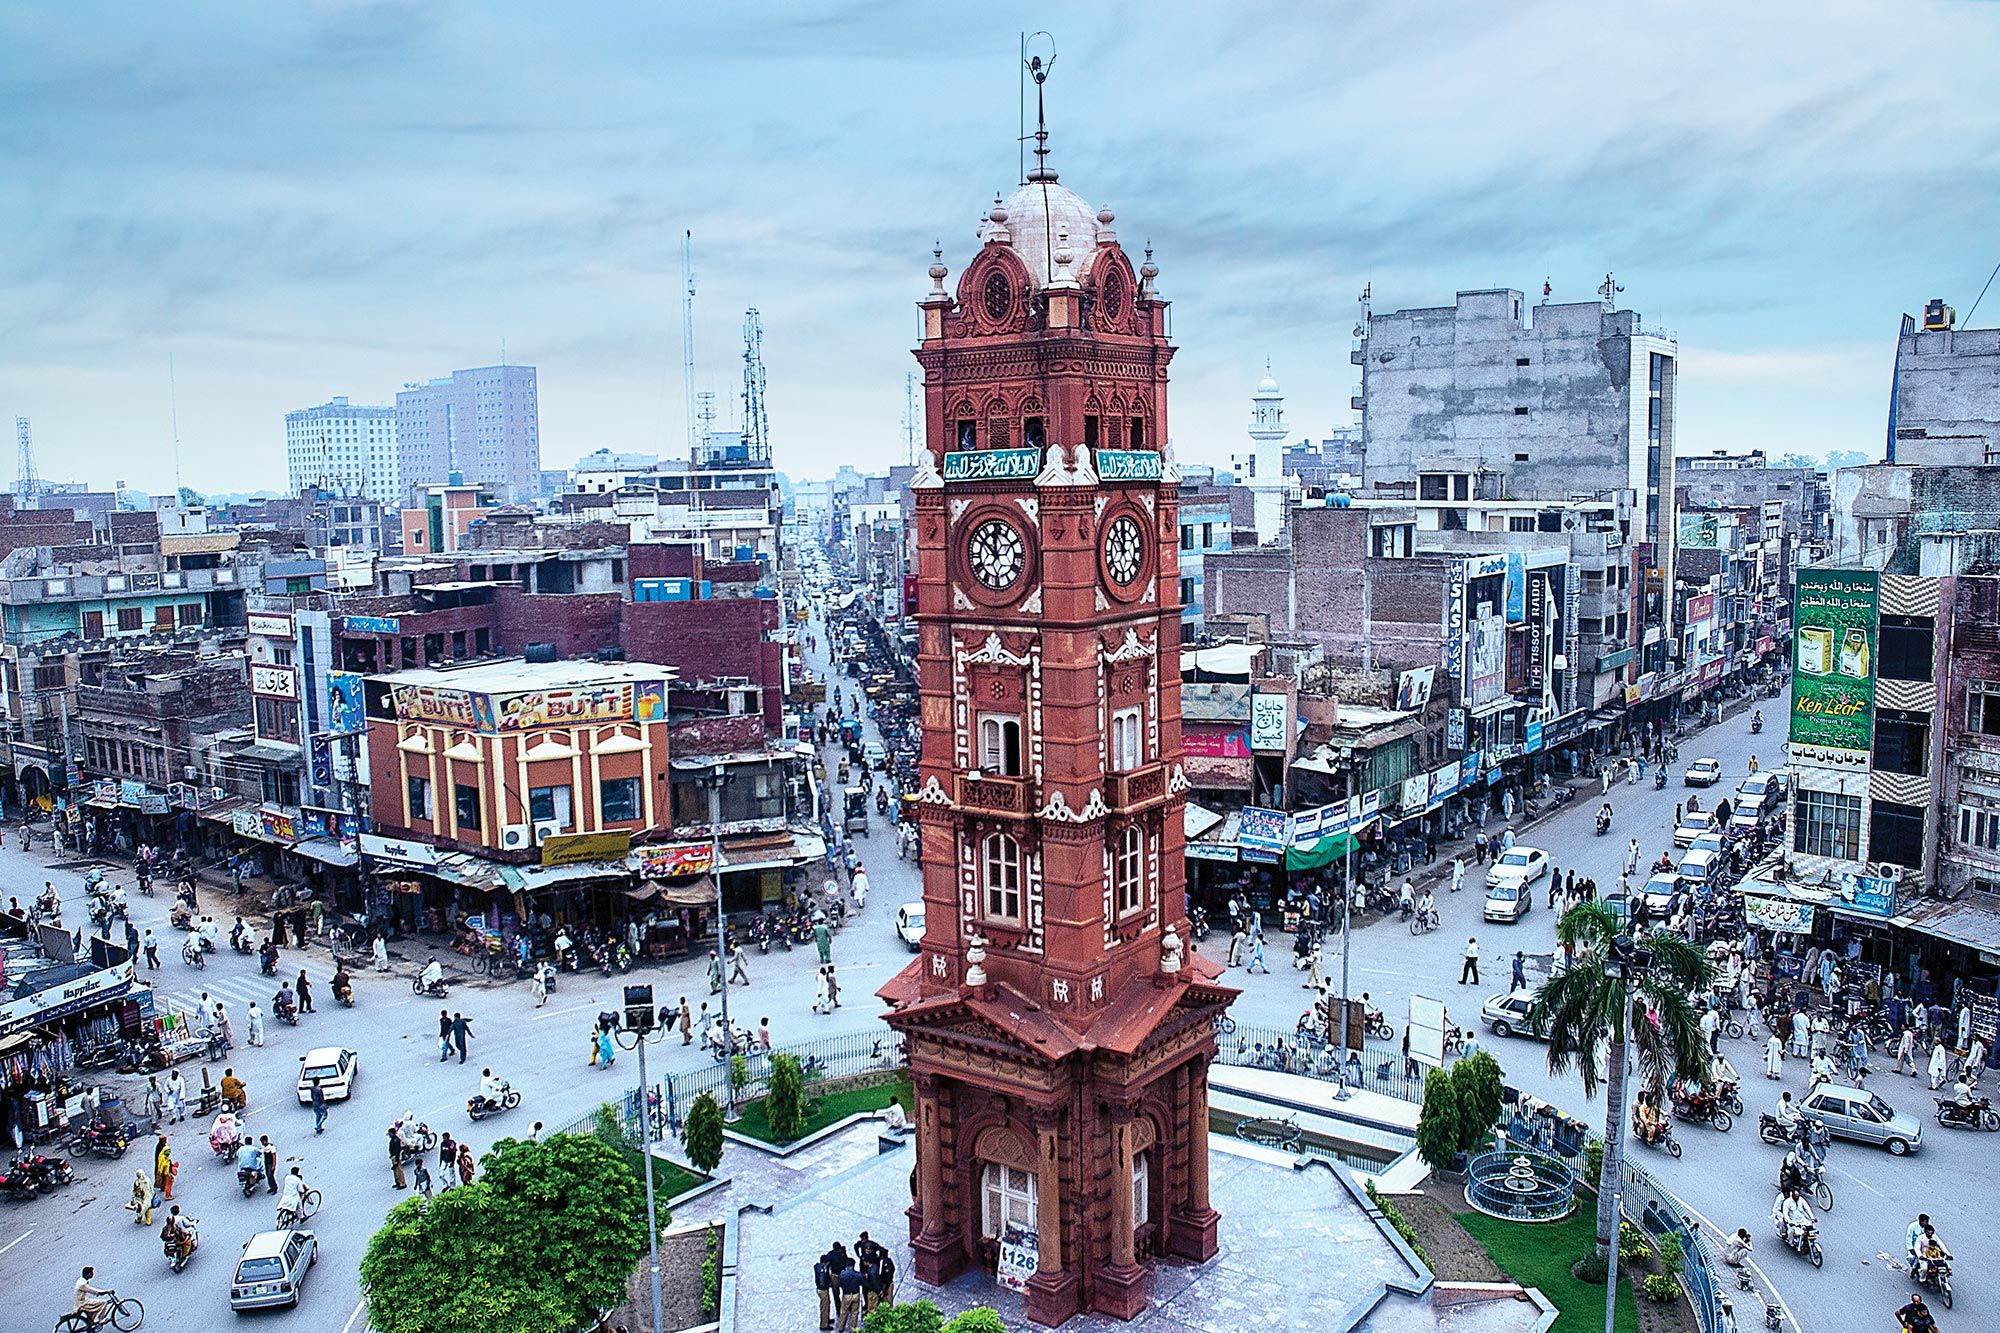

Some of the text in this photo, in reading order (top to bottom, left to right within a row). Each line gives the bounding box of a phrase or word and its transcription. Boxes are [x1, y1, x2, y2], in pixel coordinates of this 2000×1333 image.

[1450, 583, 1462, 628] SAS
[1531, 579, 1541, 617] RADO
[1531, 621, 1541, 665] TISSOT
[421, 698, 464, 719] BUTT
[547, 695, 621, 718] BUTT
[1255, 700, 1284, 715] جاپان
[1796, 697, 1865, 716] Ken Leaf
[1256, 713, 1283, 729] واچ
[1809, 716, 1838, 724] Premium
[1254, 731, 1284, 747] کمپنی
[1791, 747, 1867, 766] عرفان پان شاپ
[63, 979, 101, 1000] Happilac
[1008, 1250, 1038, 1270] 126
